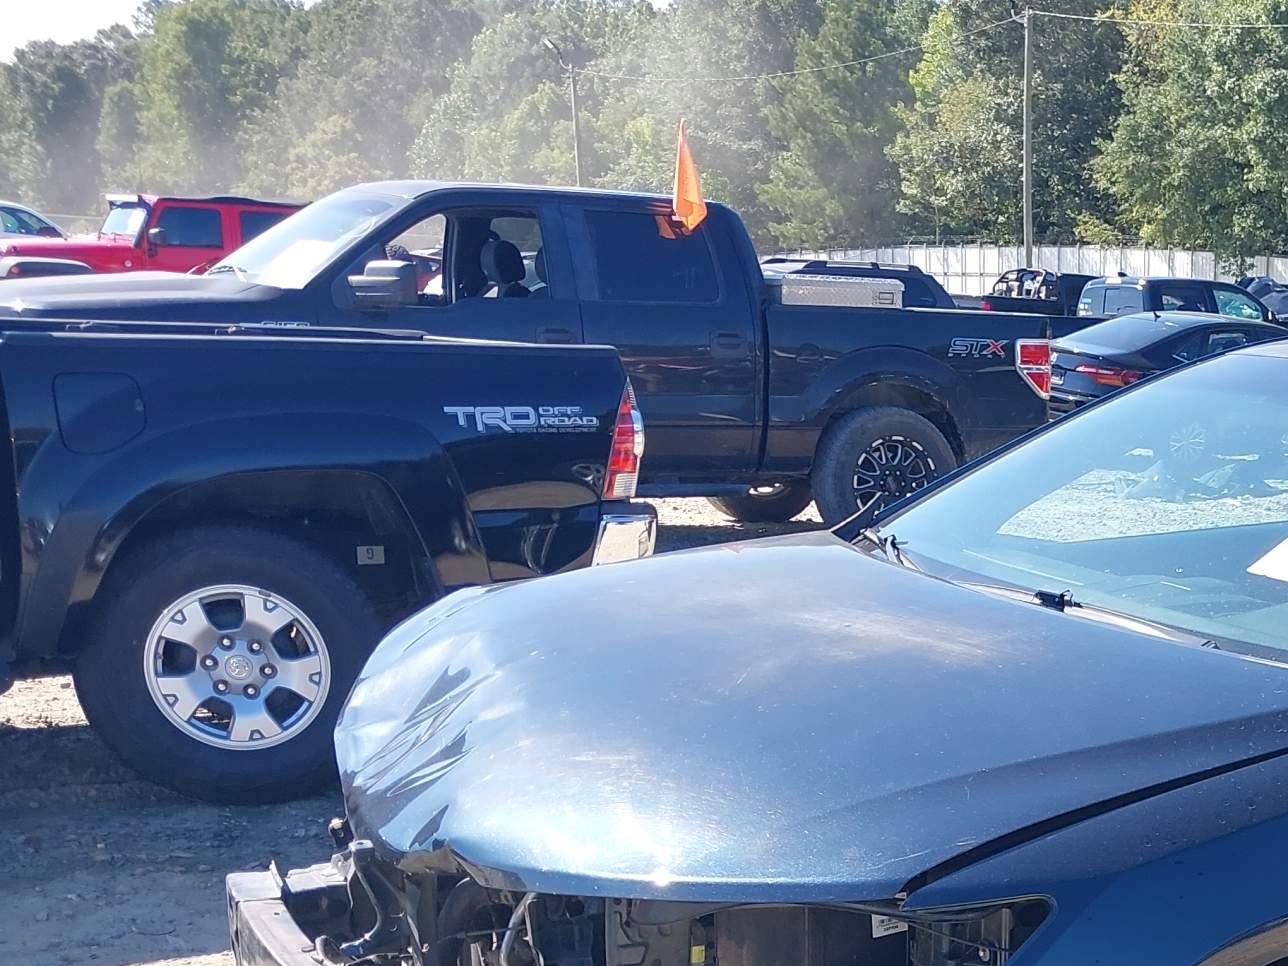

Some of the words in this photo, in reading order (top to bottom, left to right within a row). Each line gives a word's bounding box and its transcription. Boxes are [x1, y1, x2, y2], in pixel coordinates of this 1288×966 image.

[948, 337, 1009, 355] STX
[538, 406, 582, 415] OFF
[443, 406, 537, 433] TRD
[540, 416, 600, 427] ROAD
